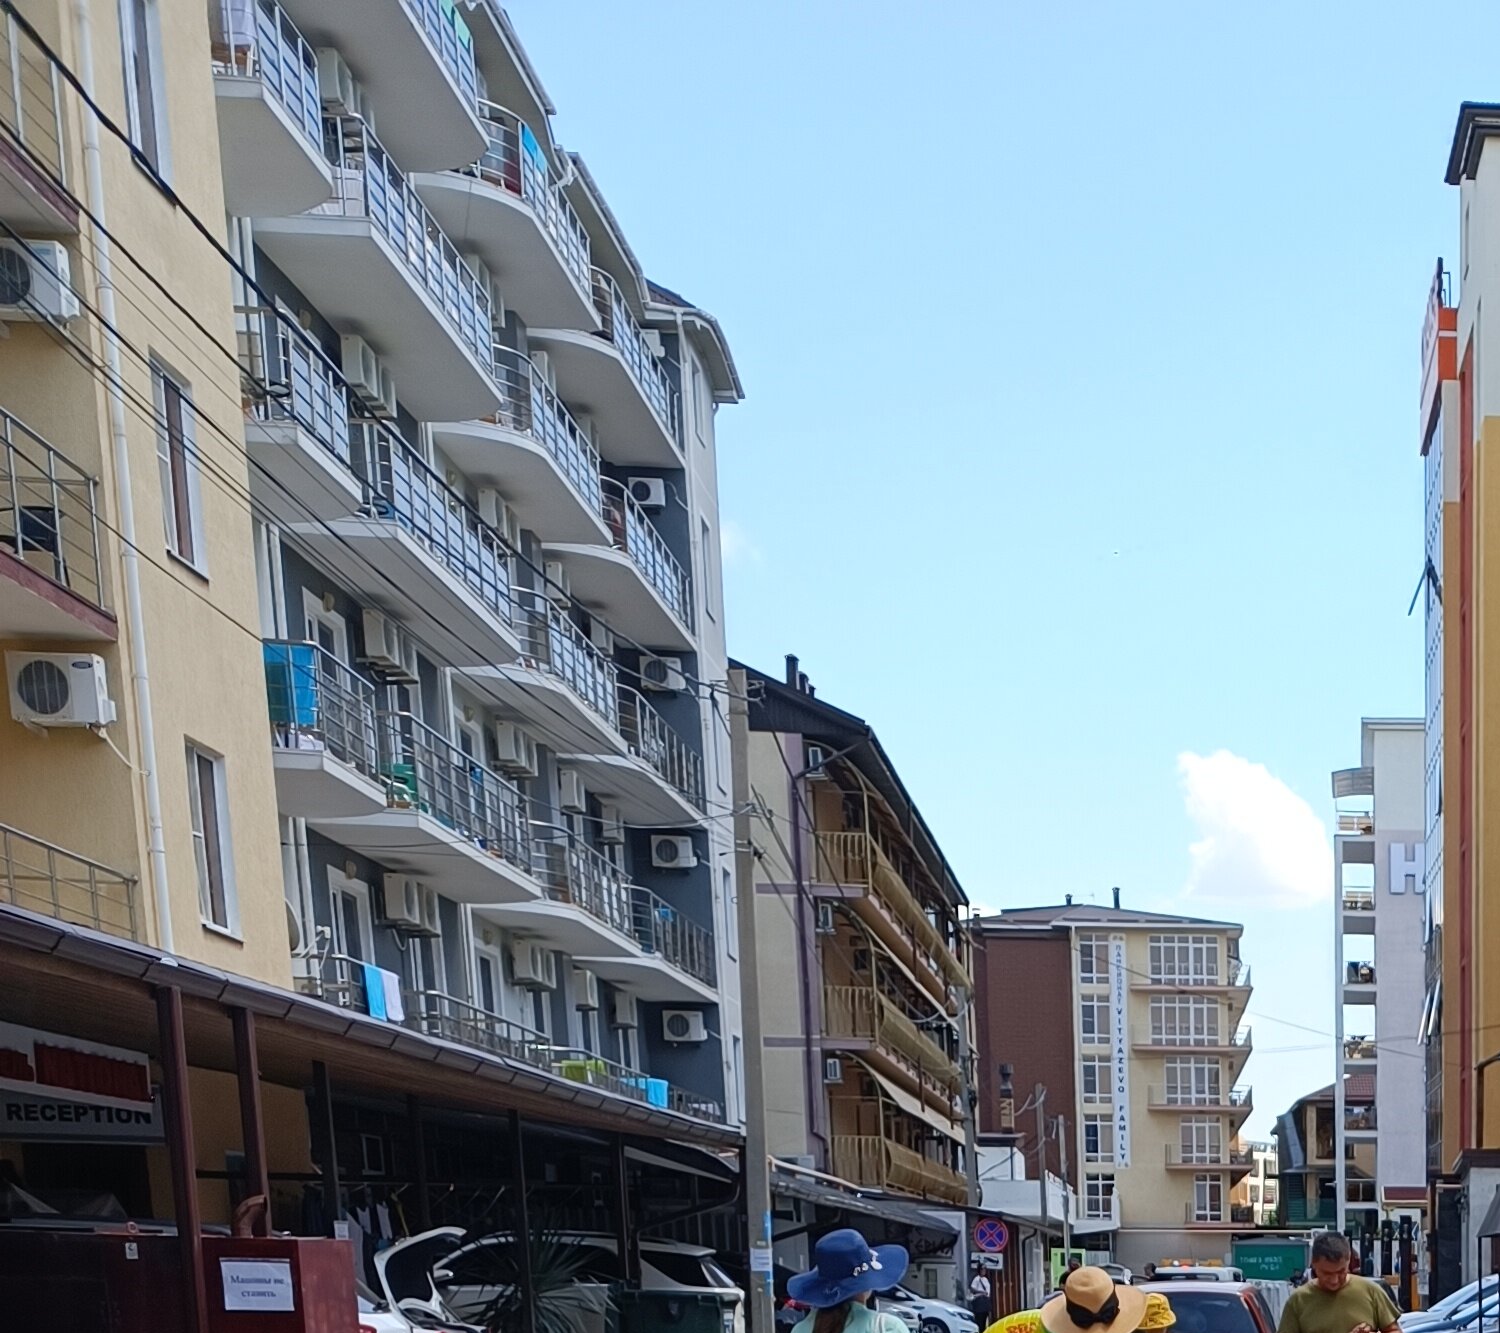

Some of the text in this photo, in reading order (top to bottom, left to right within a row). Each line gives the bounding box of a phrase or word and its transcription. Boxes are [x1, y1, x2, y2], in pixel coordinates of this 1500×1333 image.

[5, 1103, 152, 1124] RECEPTION
[1118, 1105, 1126, 1160] FAMILY
[230, 1275, 271, 1285] Машины
[241, 1290, 276, 1298] ставить
